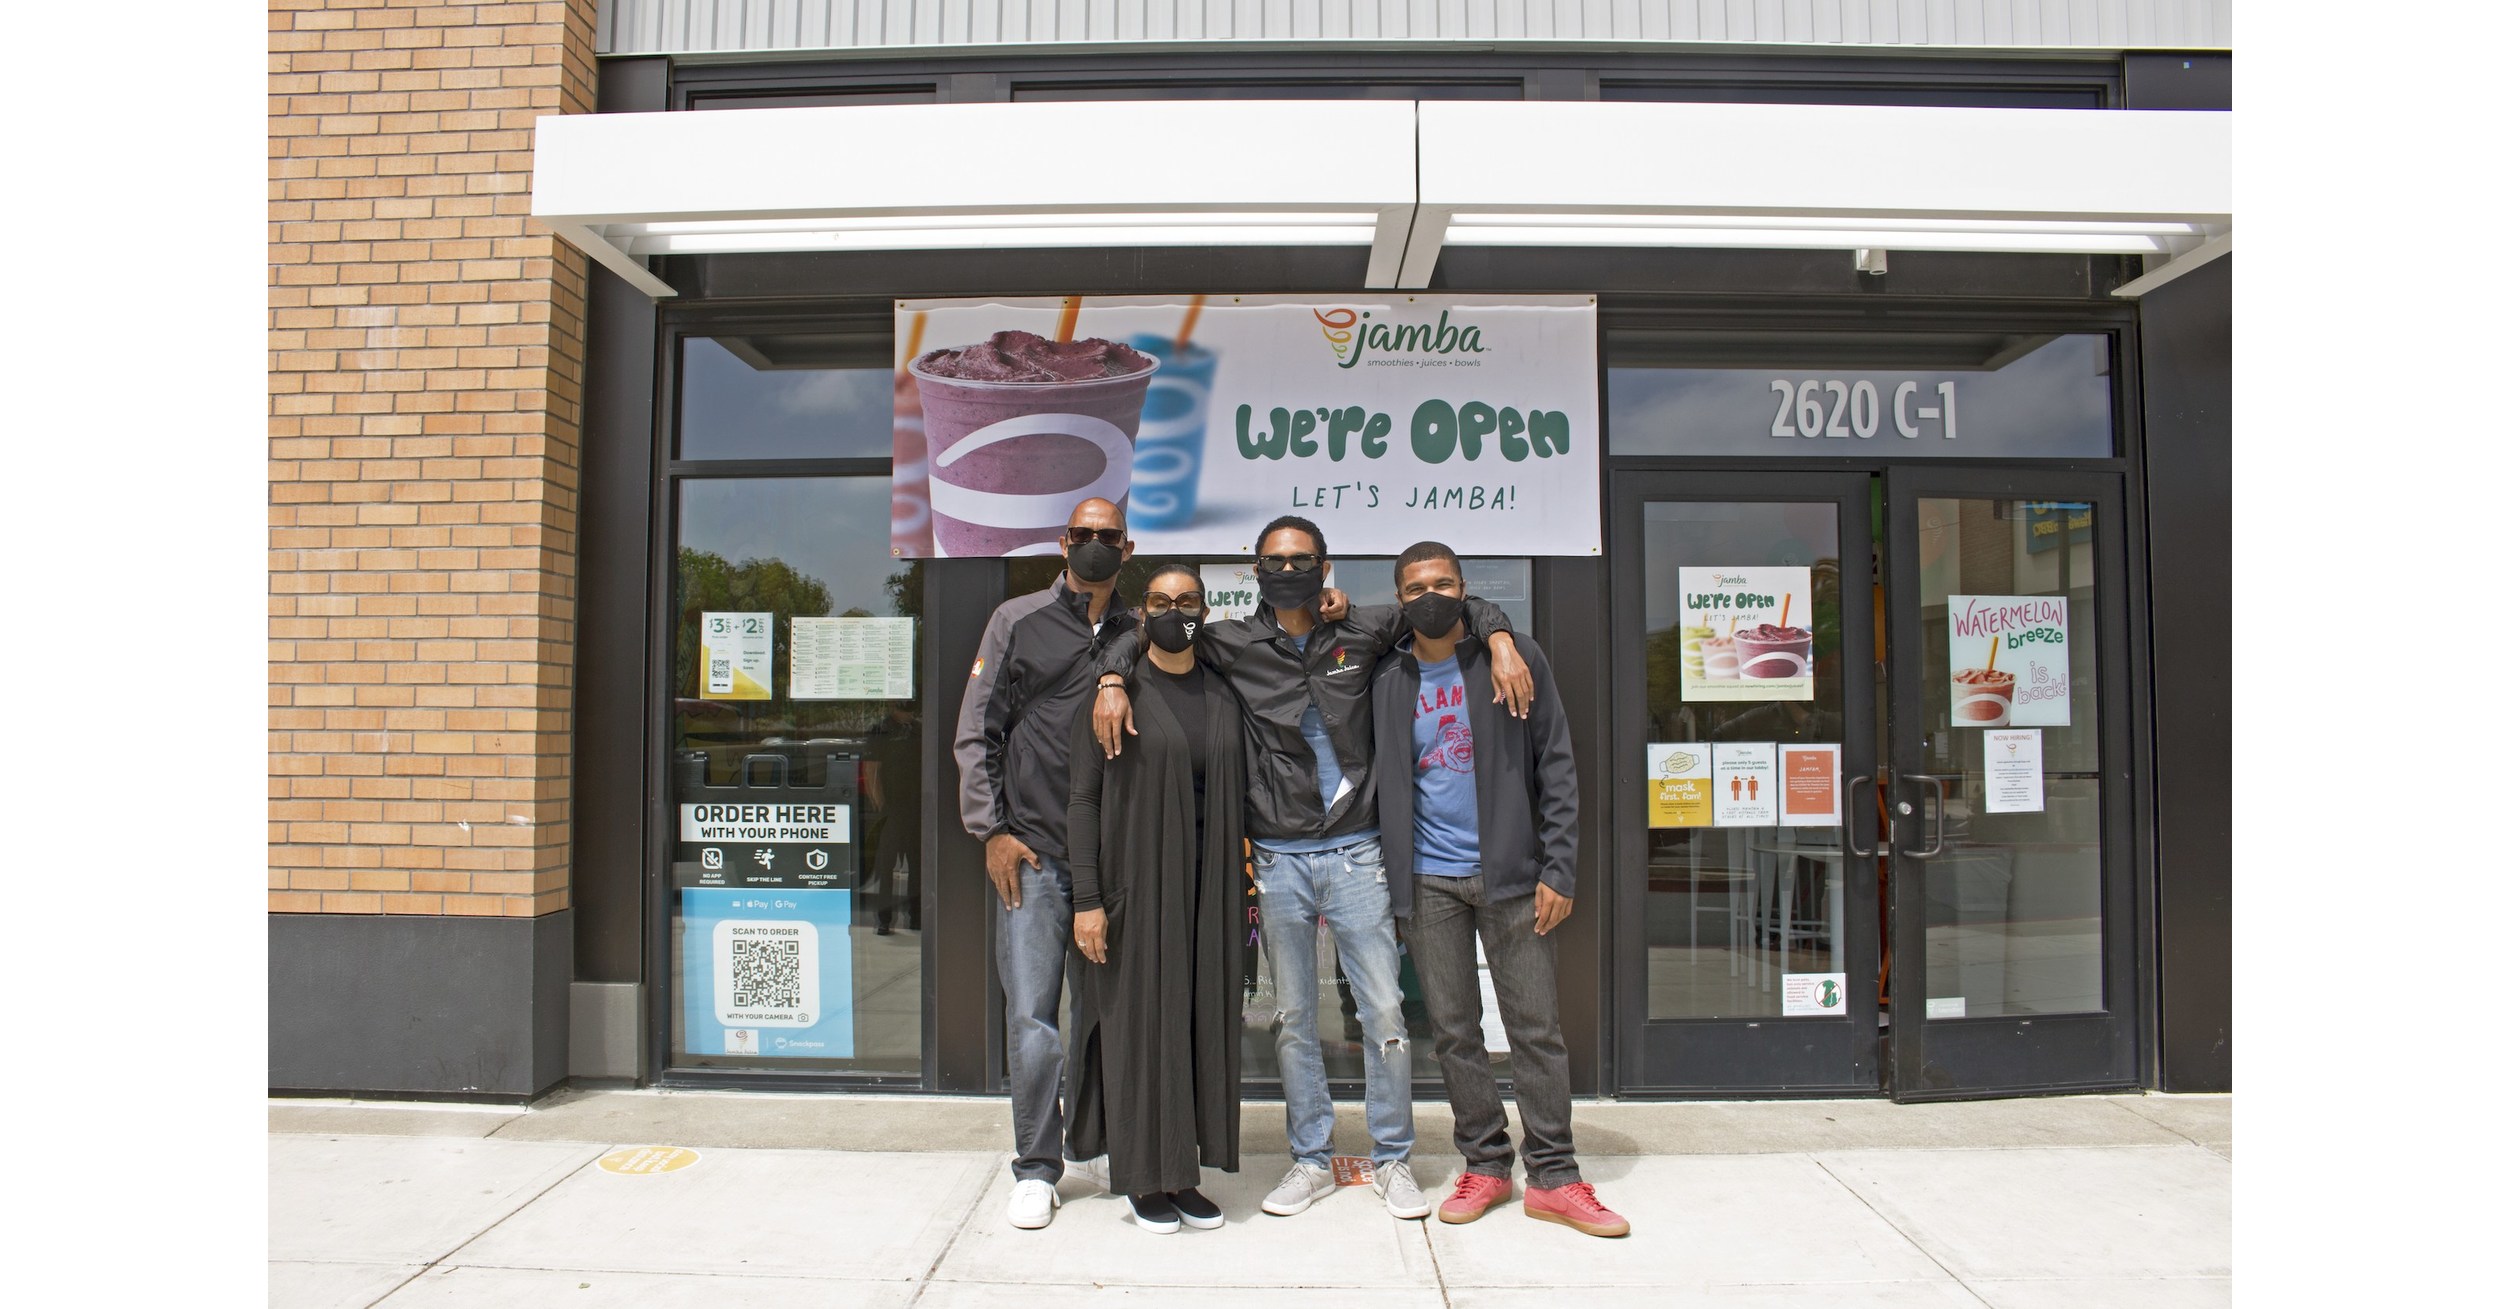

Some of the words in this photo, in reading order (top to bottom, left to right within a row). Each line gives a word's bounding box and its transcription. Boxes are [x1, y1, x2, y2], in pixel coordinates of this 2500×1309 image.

[1338, 310, 1485, 369] jamba
[1367, 358, 1414, 367] smoothies
[1419, 358, 1447, 369] juices
[1454, 357, 1481, 367] bowls
[1770, 379, 1880, 439] 2620
[1893, 380, 1957, 439] C-1
[1235, 403, 1392, 463] We're
[1292, 481, 1379, 510] LET'S
[1406, 485, 1517, 511] JAMBA!
[1717, 574, 1748, 588] jamba
[1207, 590, 1253, 607] We're
[1687, 592, 1732, 610] We're
[1953, 598, 2063, 638] WATERMELON
[2007, 627, 2064, 650] breeze
[2030, 660, 2050, 684] is
[2017, 673, 2067, 706] back!
[1665, 780, 1696, 792] mask
[694, 805, 770, 823] ORDER
[776, 806, 836, 824] HERE
[701, 827, 735, 838] WITH
[739, 827, 777, 839] YOUR
[780, 828, 829, 839] PHONE
[754, 900, 769, 910] Pay
[783, 900, 797, 910] Pay
[769, 928, 799, 936] ORDER
